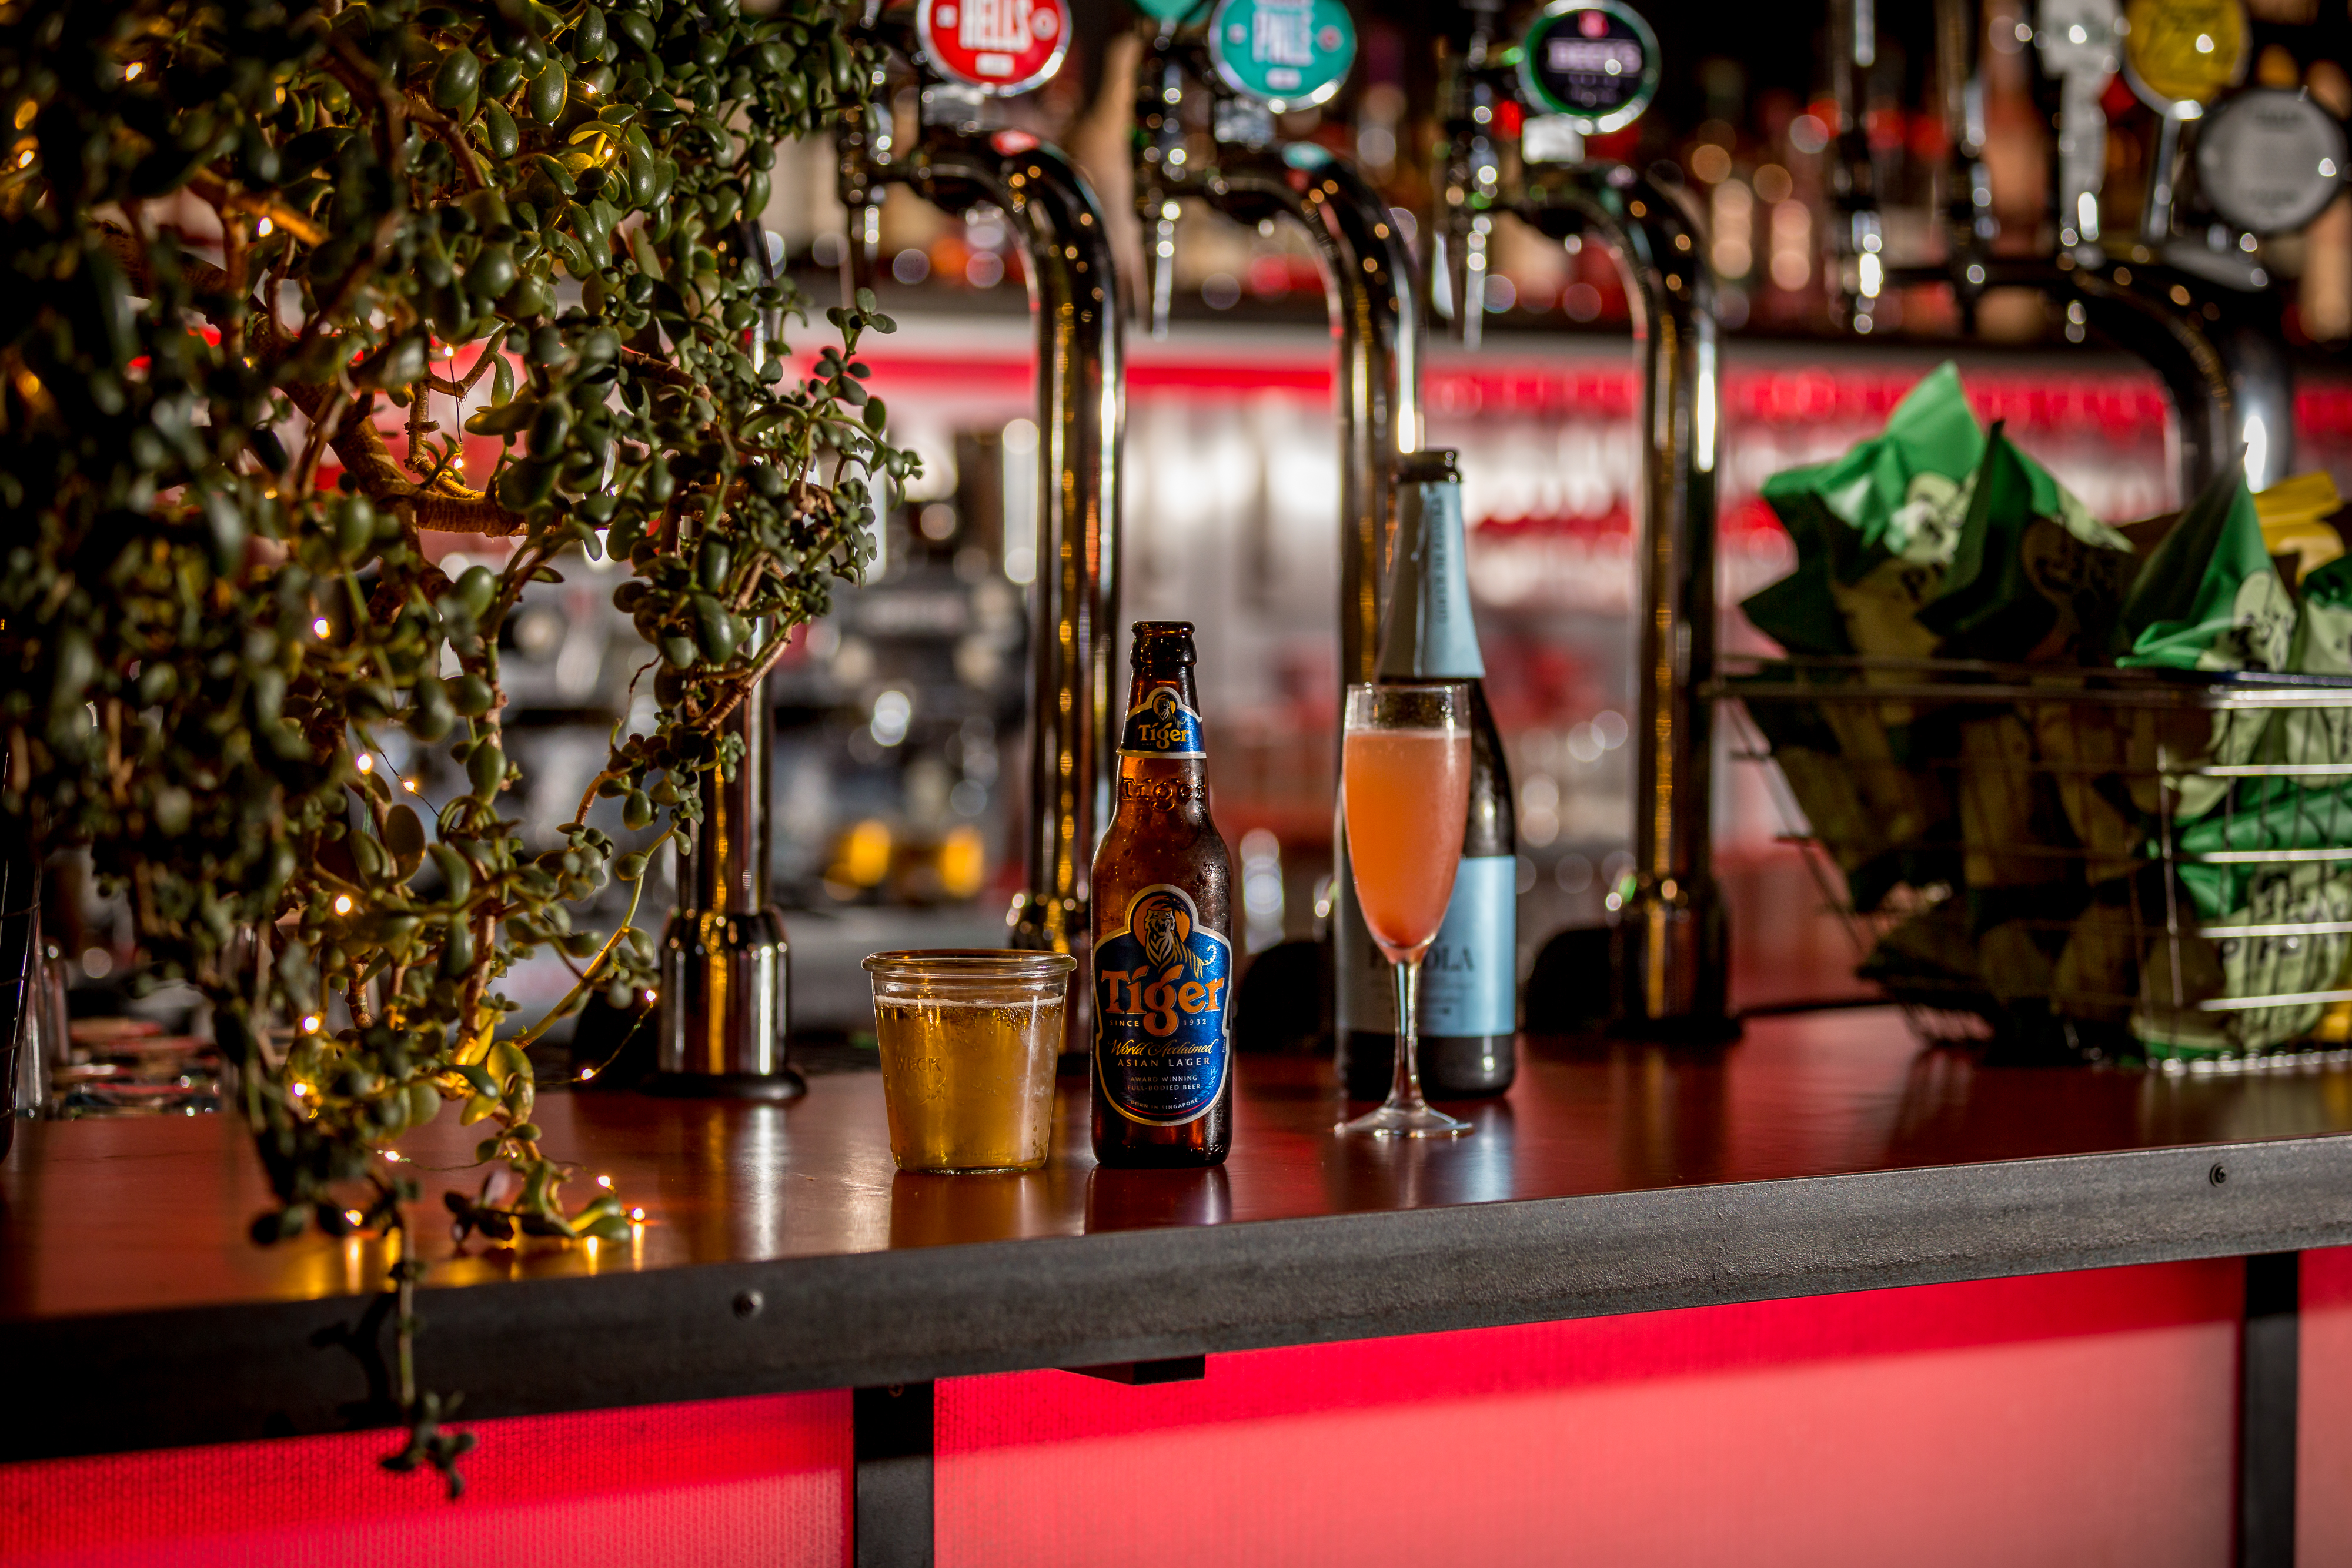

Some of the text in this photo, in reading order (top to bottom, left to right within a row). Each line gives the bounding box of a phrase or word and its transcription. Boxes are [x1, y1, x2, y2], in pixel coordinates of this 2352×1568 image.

[1138, 723, 1189, 749] Tiger
[1101, 964, 1225, 1037] Tiger
[1108, 1039, 1147, 1056] World
[1148, 1038, 1219, 1057] Acclaimed
[1169, 1057, 1210, 1066] LAGER
[1130, 1099, 1148, 1109] BORN
[1162, 1098, 1198, 1109] SINGAPORE
